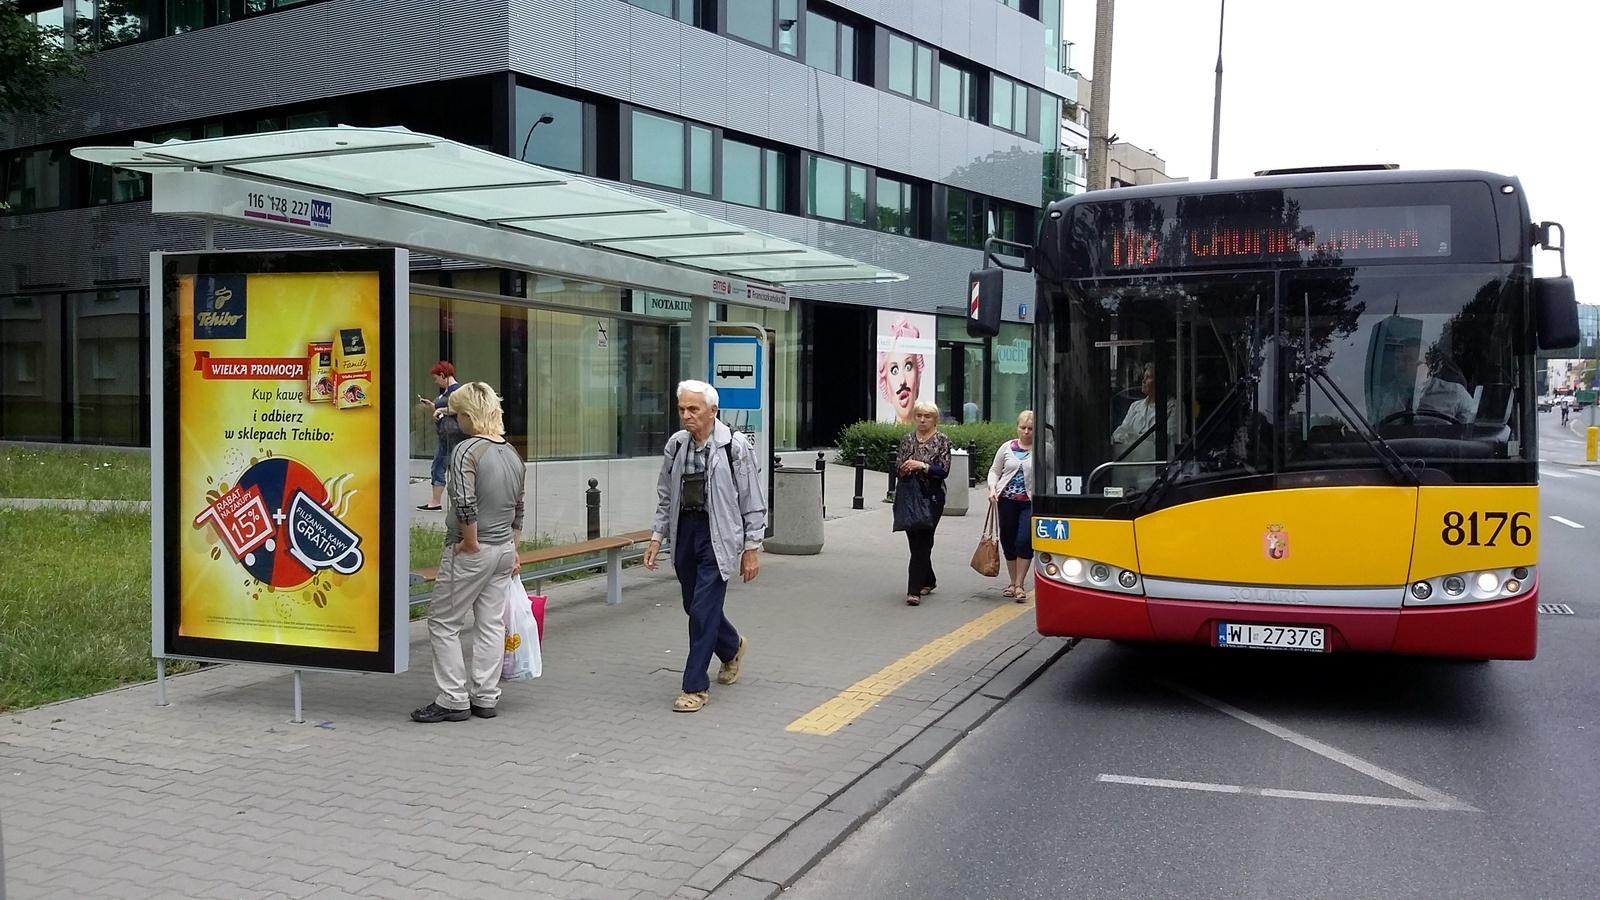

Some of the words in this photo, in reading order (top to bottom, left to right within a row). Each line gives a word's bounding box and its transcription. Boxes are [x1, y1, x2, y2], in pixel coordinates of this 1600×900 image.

[247, 192, 264, 209] 116
[270, 196, 288, 213] 178
[292, 200, 309, 216] 227
[312, 203, 331, 220] N44
[713, 280, 727, 292] ams
[651, 298, 693, 312] NOTARIUS
[197, 310, 244, 327] Tchibo
[212, 364, 249, 375] WIELKA
[250, 364, 304, 378] PROMOCJA
[343, 358, 368, 370] Family
[252, 388, 272, 402] Kup
[276, 387, 304, 403] kawę
[253, 410, 257, 422] i
[261, 410, 303, 424] odbierz
[225, 431, 234, 440] w
[237, 427, 287, 442] sklepach
[292, 428, 334, 442] Tchibo:
[1064, 477, 1073, 493] 8
[216, 488, 241, 512] RABAT
[220, 508, 231, 519] NA
[230, 491, 252, 513] ZAKUPY
[232, 508, 260, 543] 15%
[296, 506, 327, 536] FILIŻANKA
[327, 533, 348, 551] KAWY
[1441, 511, 1532, 547] 8176
[296, 520, 337, 557] GRATIS
[1229, 587, 1309, 603] SOLARIS
[1230, 625, 1252, 643] WI
[1263, 627, 1322, 647] 2737G
